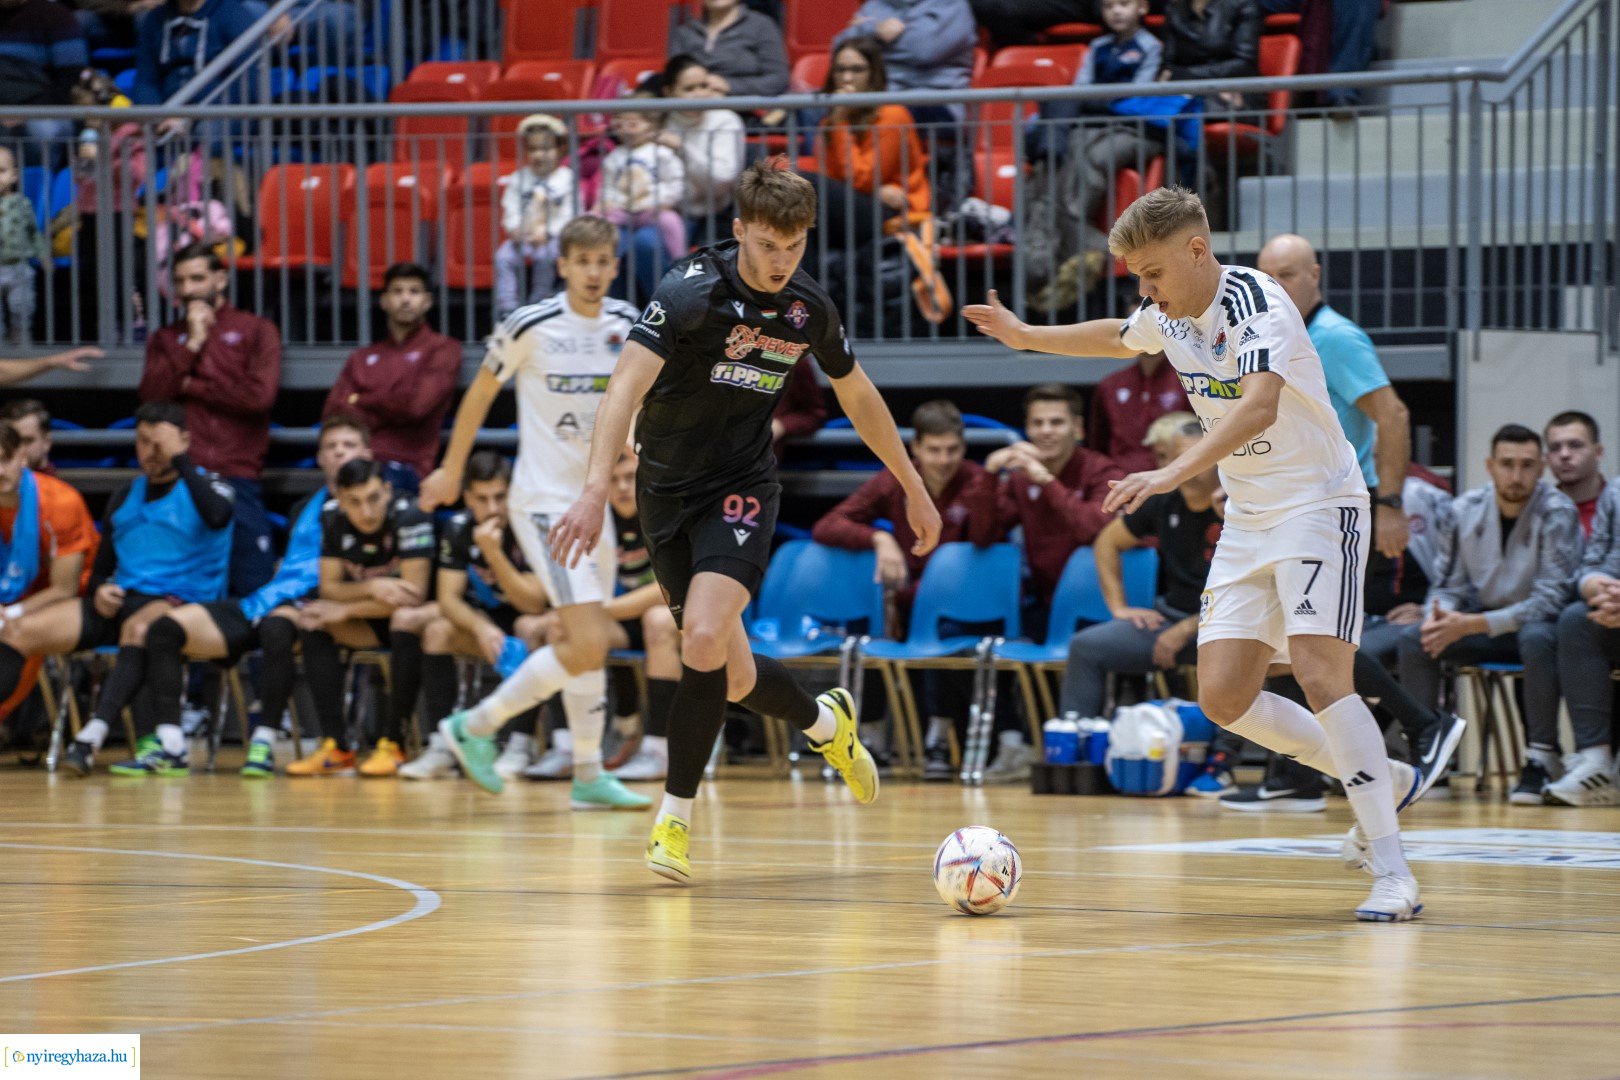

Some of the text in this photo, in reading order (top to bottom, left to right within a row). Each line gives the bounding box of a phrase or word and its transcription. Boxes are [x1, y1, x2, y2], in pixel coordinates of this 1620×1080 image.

[1158, 315, 1190, 340] 383
[1239, 333, 1260, 346] adidas
[723, 494, 761, 527] 92
[1301, 559, 1323, 595] 7
